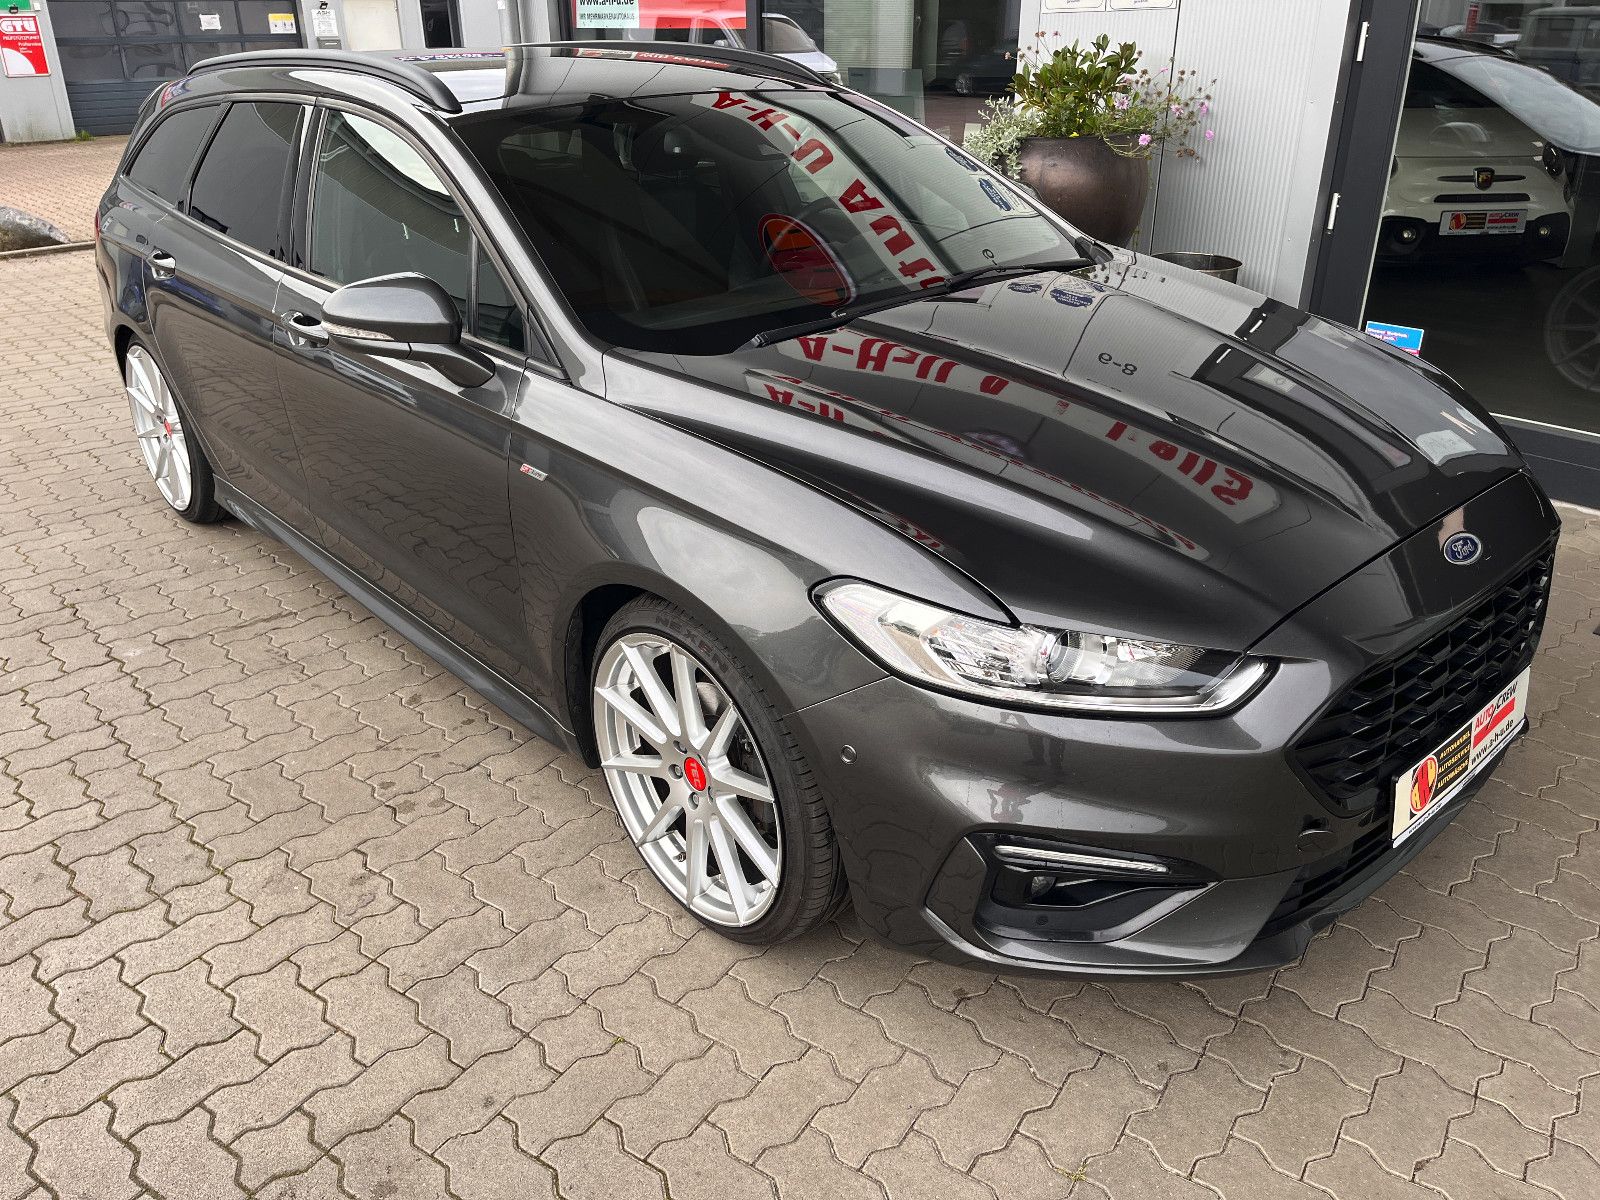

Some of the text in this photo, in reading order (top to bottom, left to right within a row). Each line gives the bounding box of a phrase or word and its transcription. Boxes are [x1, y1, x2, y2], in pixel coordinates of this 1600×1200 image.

[1451, 539, 1475, 560] Ford
[1439, 732, 1471, 760] AUTOHANDEL
[1471, 719, 1514, 765] www.a-h-u.de
[1436, 758, 1469, 790] AUTOWÄSCHE
[1437, 744, 1471, 774] AUTOSERVICE
